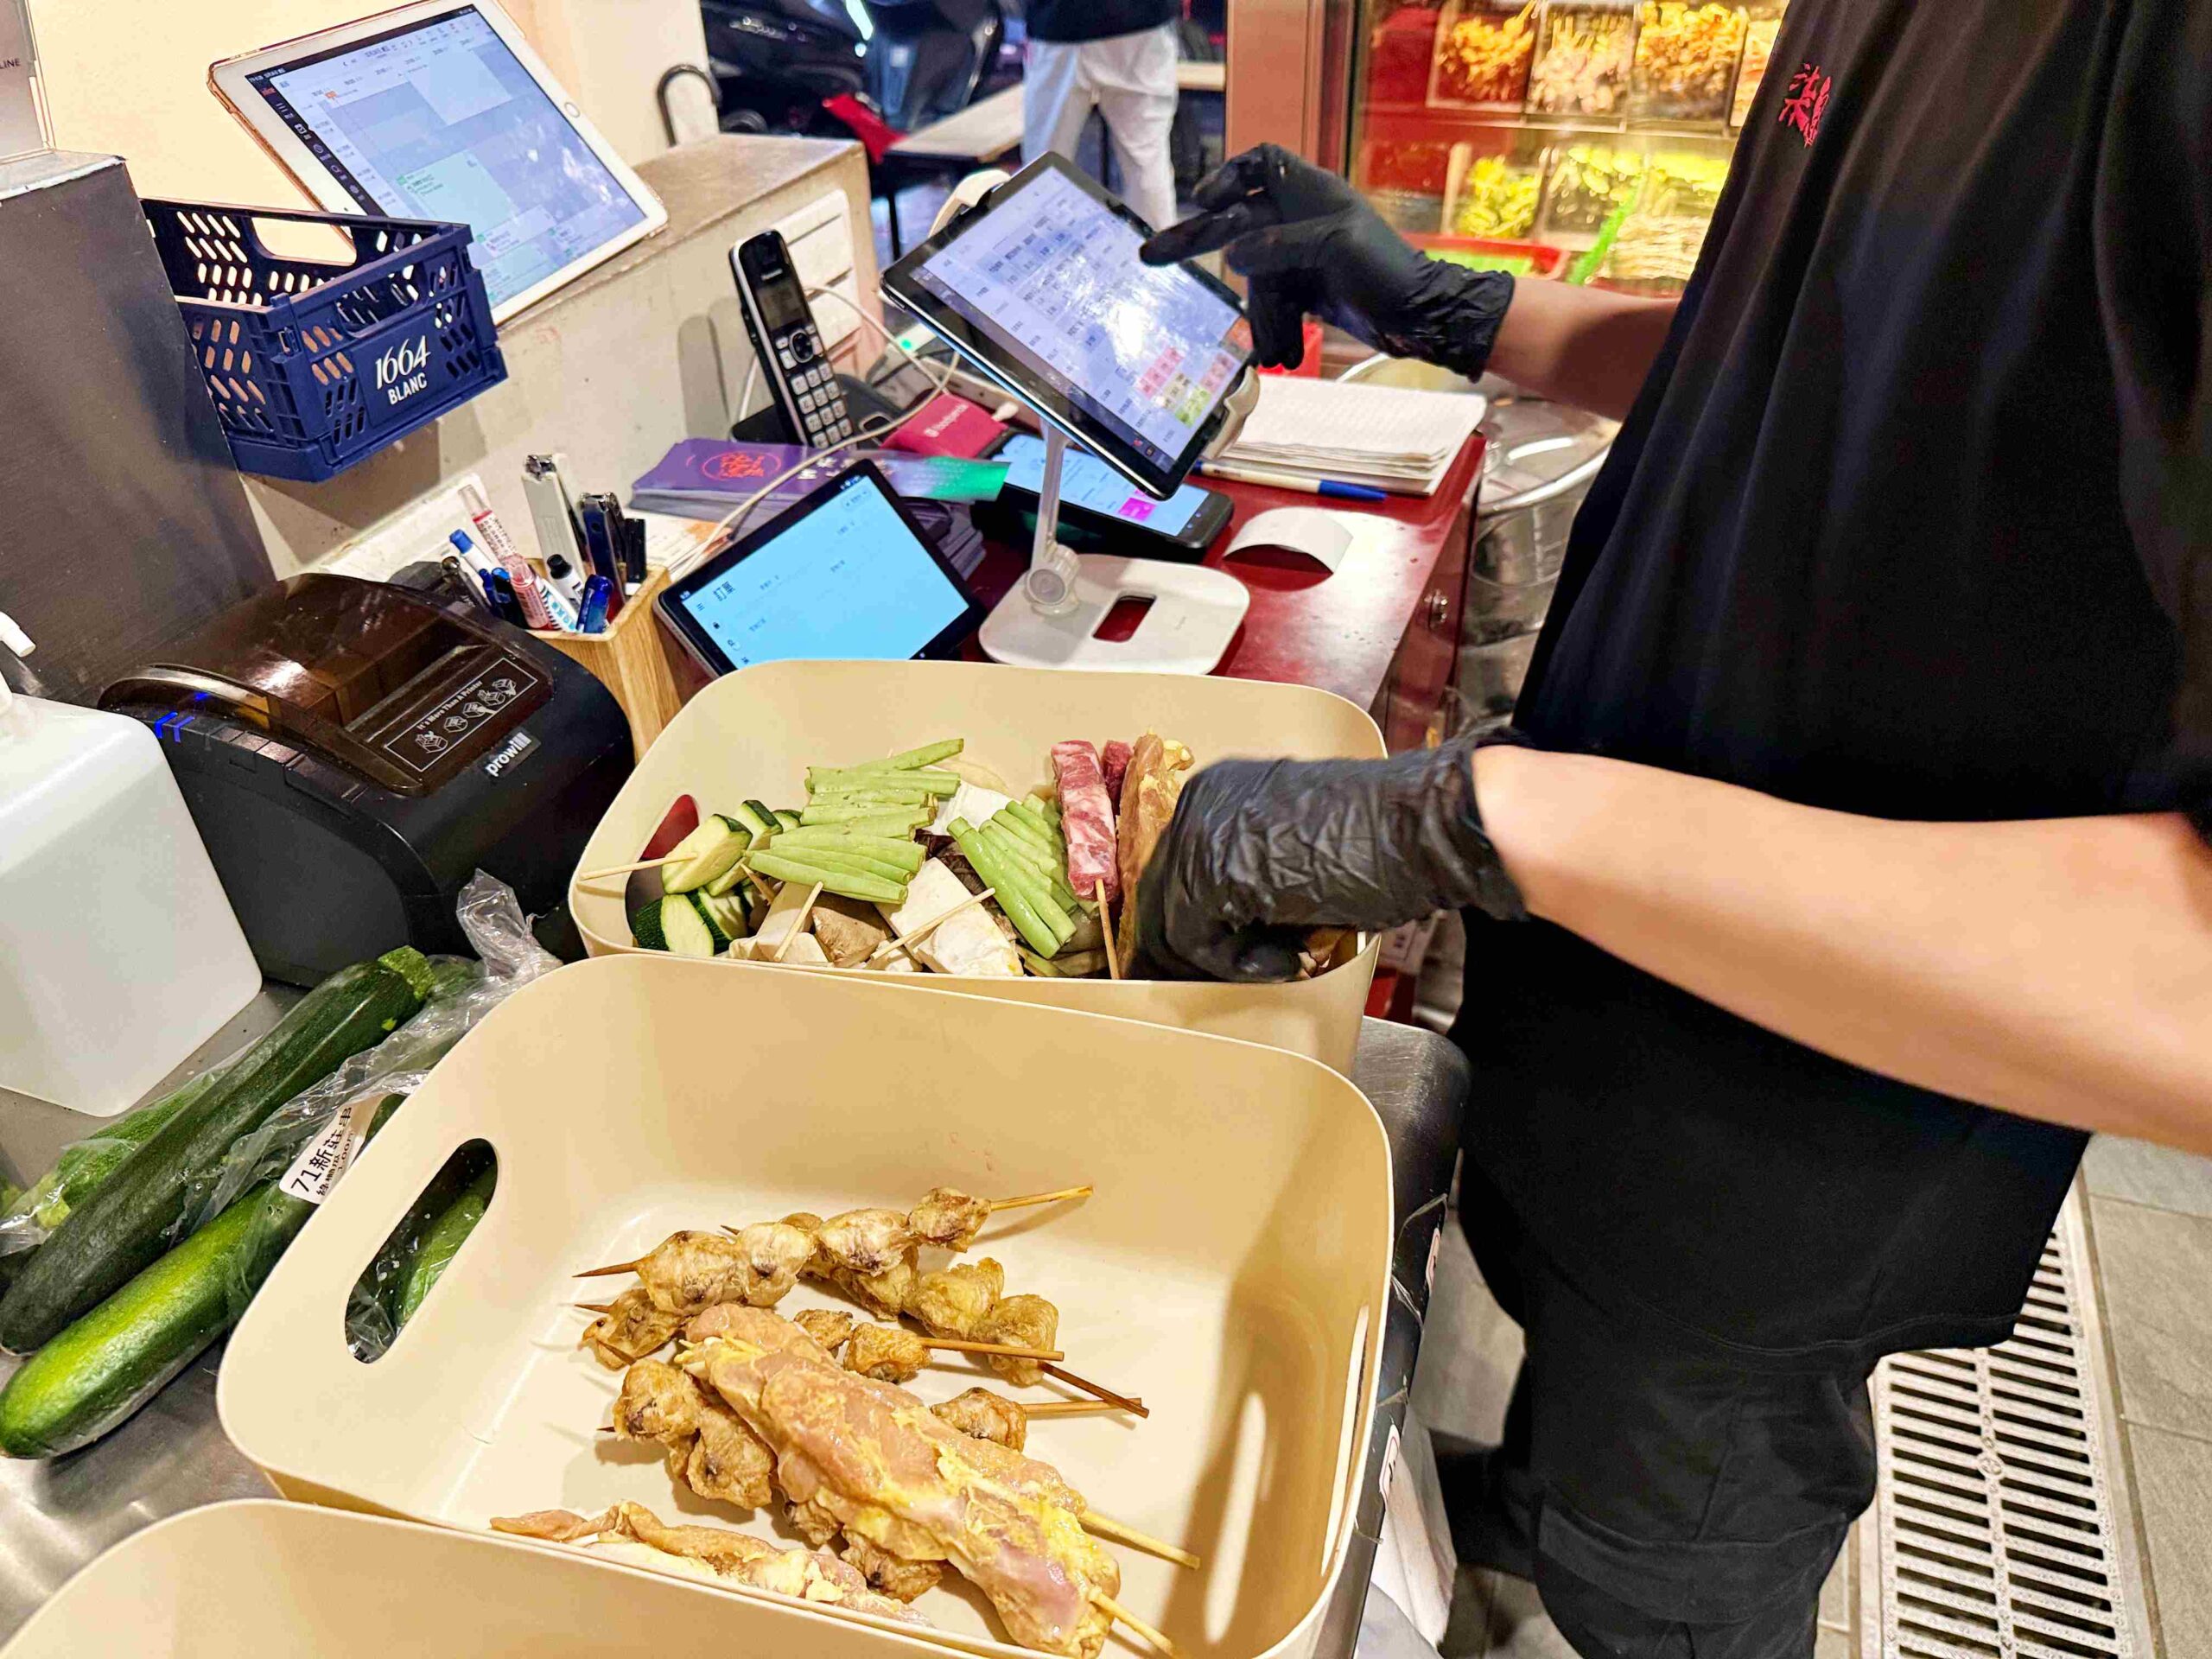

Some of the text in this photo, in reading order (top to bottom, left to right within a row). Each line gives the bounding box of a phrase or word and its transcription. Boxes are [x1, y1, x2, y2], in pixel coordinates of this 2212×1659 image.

[375, 334, 431, 391] 1664
[387, 372, 428, 405] BLANC
[416, 721, 431, 730] It's
[427, 709, 445, 722] More
[442, 699, 460, 711] Than
[461, 681, 483, 696] Printer
[485, 732, 532, 778] prowill
